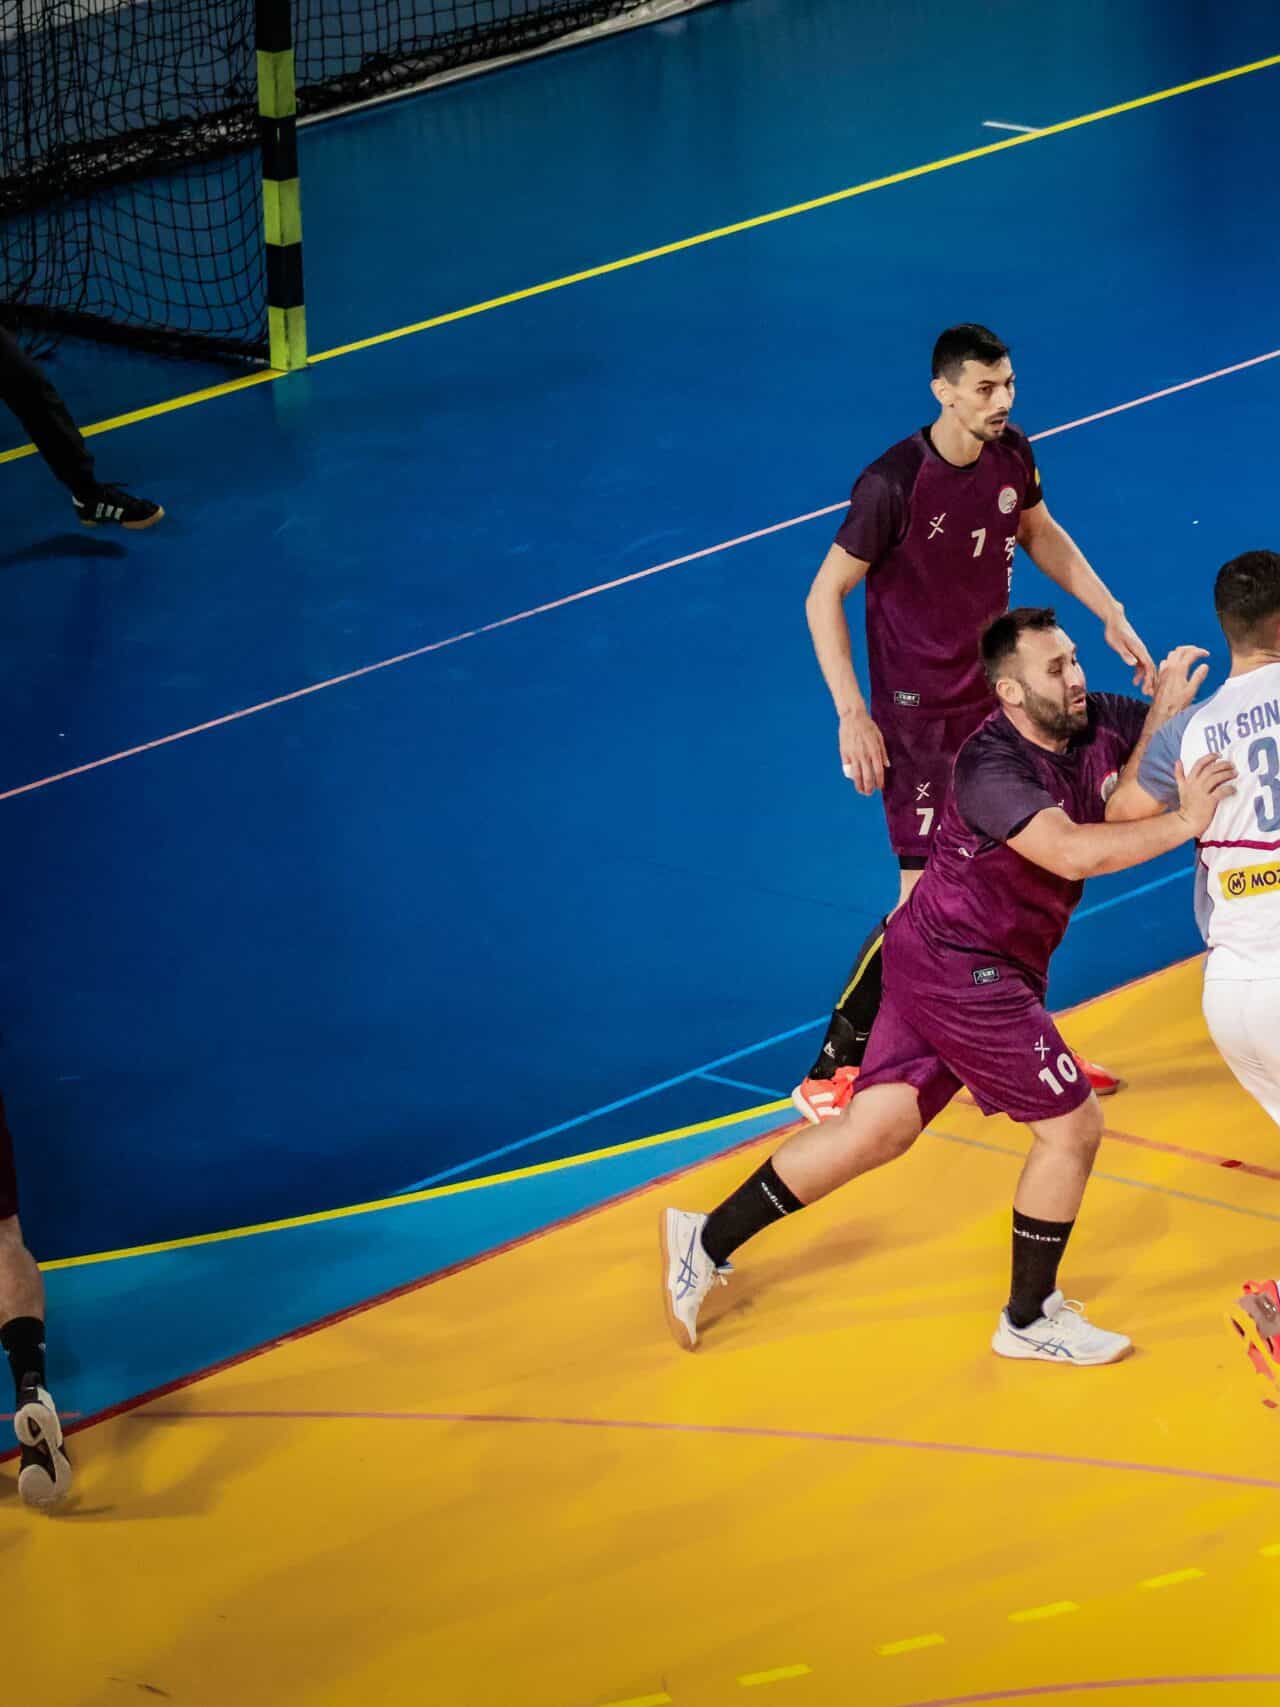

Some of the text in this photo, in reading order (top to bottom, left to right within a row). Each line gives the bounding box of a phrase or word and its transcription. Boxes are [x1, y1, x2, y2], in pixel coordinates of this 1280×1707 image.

[971, 528, 986, 558] 7
[1204, 720, 1232, 753] RK
[916, 807, 934, 836] 7
[1038, 1053, 1078, 1096] 10
